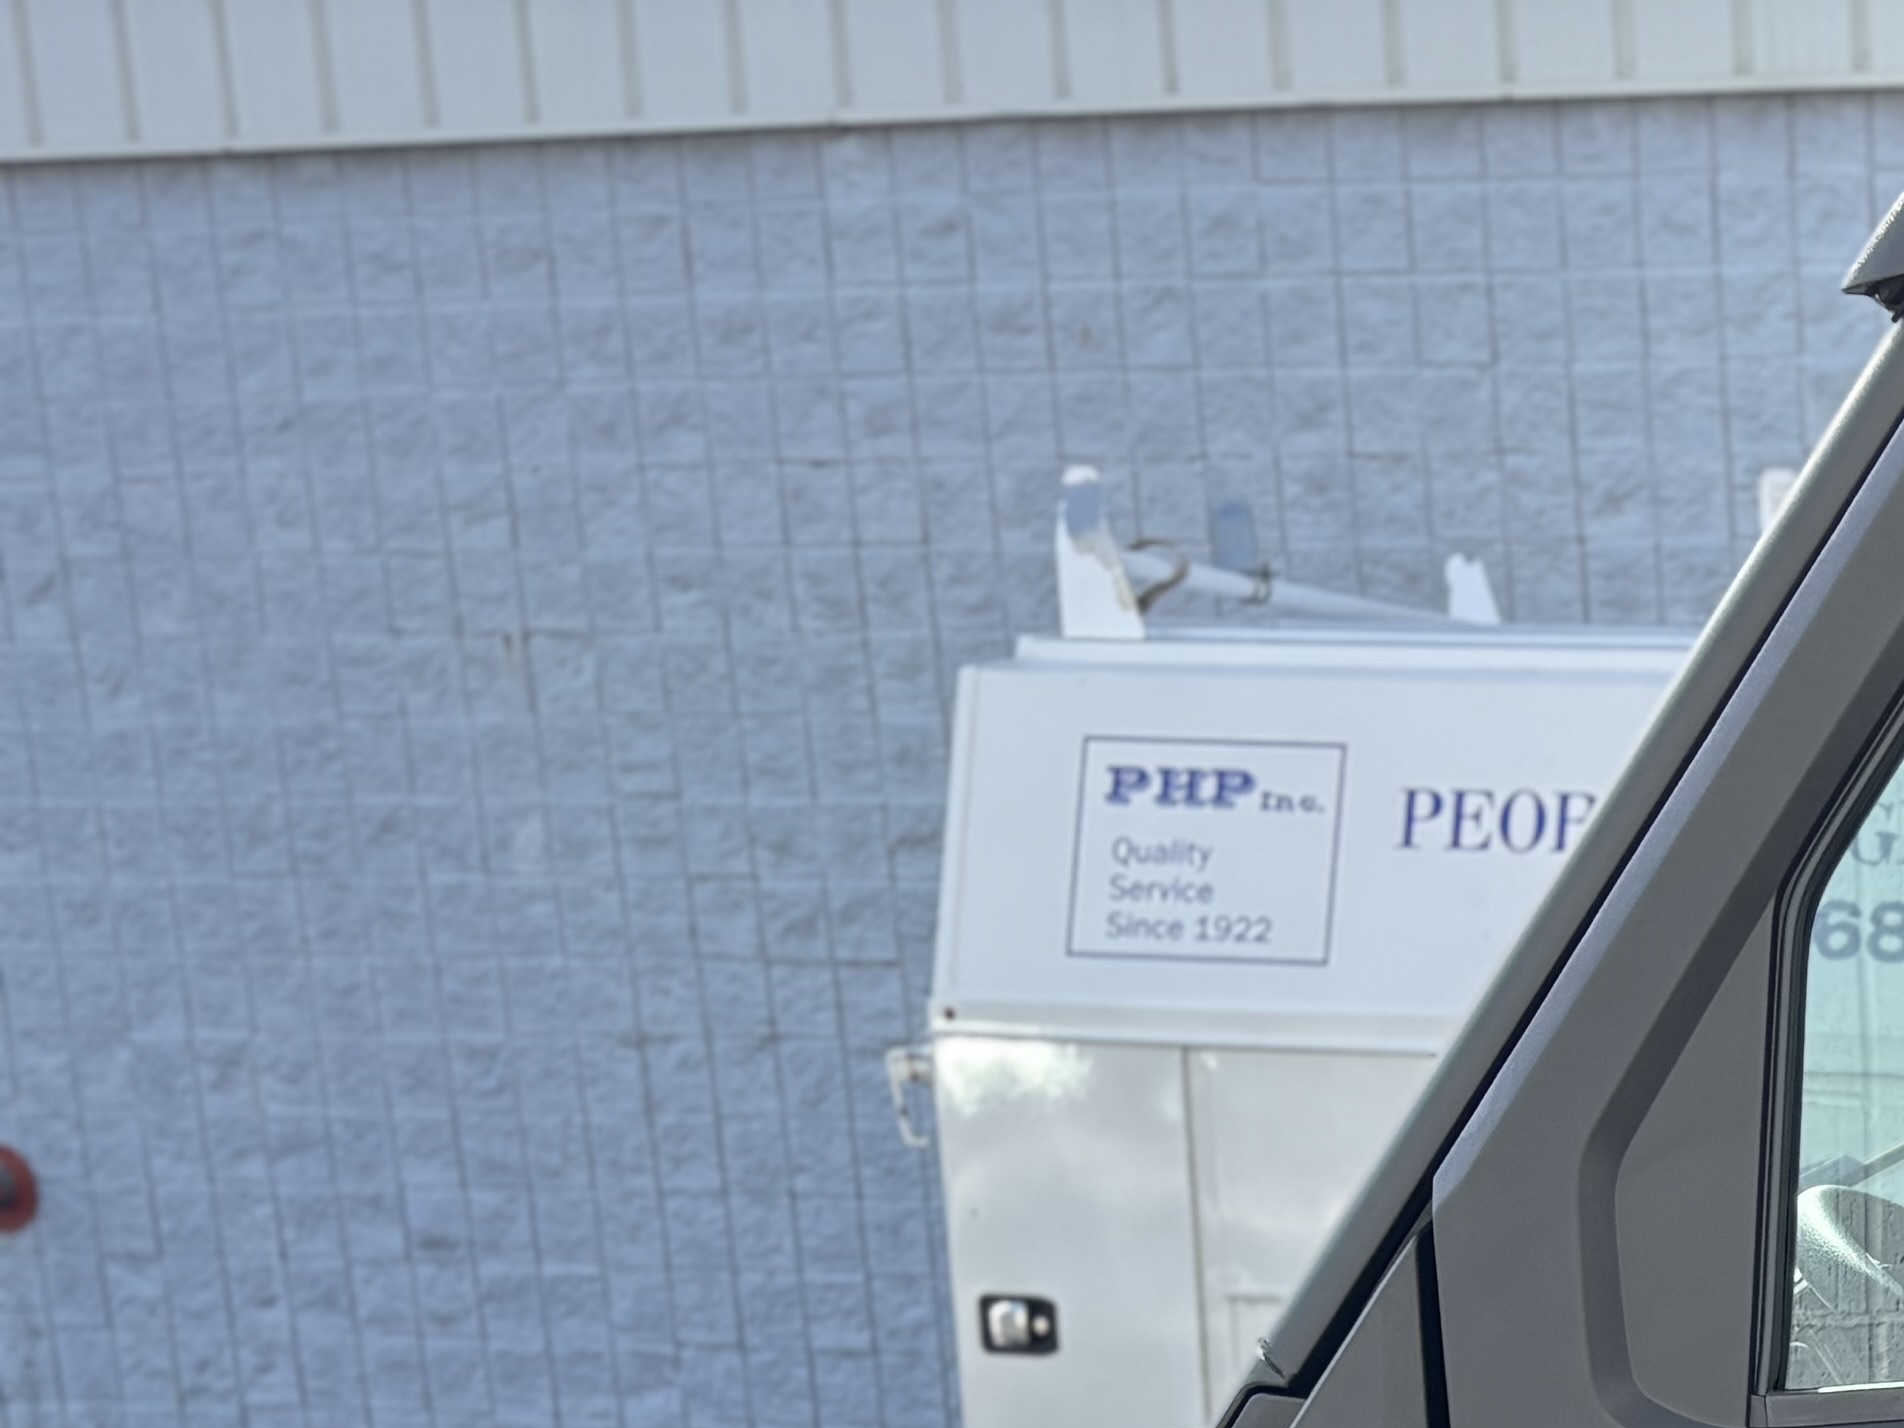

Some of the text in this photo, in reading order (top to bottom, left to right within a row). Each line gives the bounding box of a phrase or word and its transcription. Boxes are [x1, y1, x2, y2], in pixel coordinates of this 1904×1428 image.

[1105, 765, 1326, 814] PHP Inc.
[1111, 836, 1213, 873] Quality
[1108, 873, 1214, 903] Service
[1105, 909, 1273, 944] Since 1922
